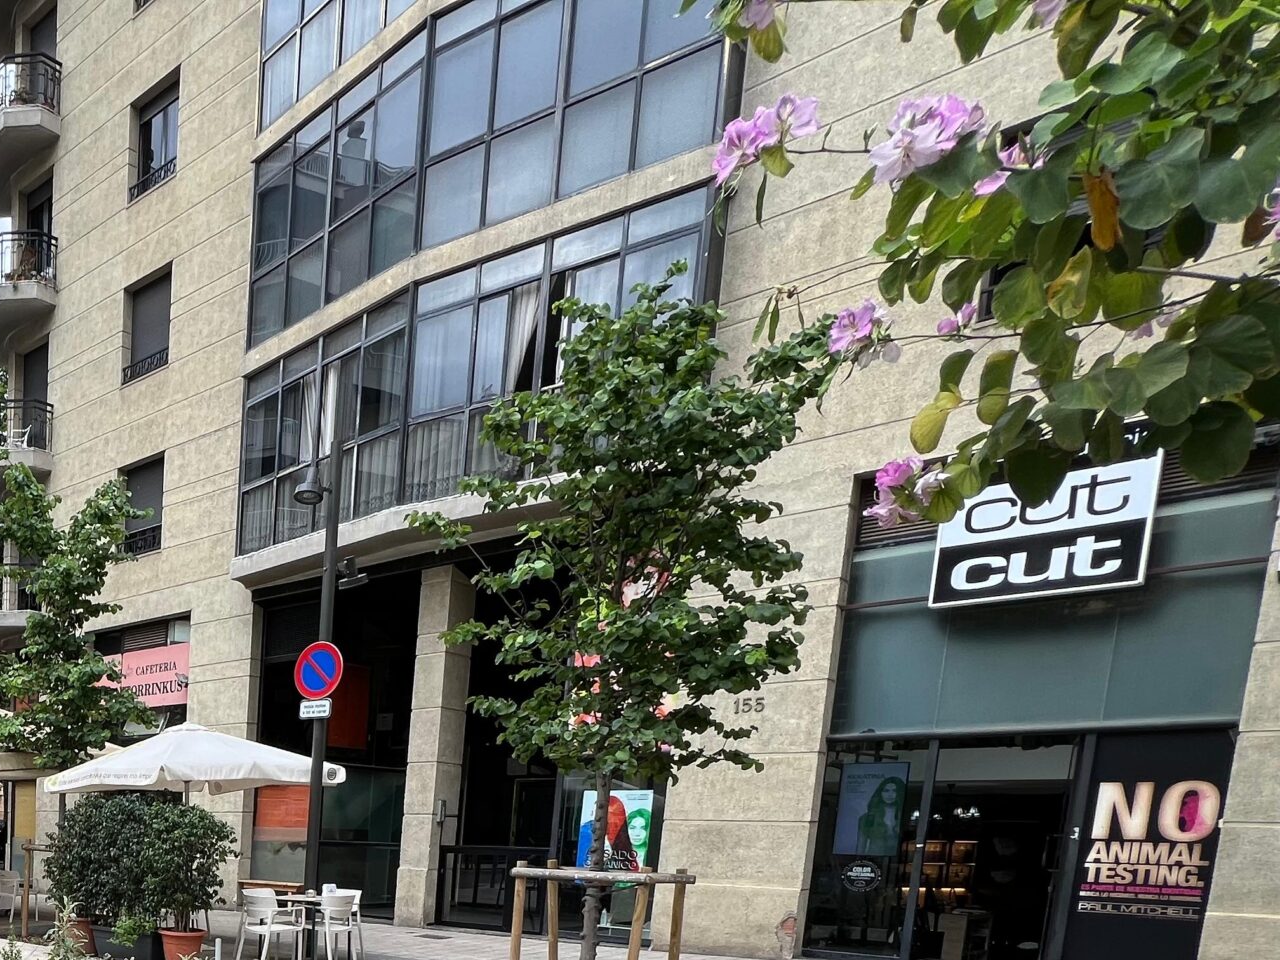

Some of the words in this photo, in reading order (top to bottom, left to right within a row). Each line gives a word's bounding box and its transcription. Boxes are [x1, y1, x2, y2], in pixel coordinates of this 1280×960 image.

[964, 474, 1131, 534] cut
[950, 535, 1123, 591] cut
[135, 661, 177, 676] CAFETERIA
[122, 680, 183, 697] ORRINKUS
[734, 697, 766, 715] 155
[1091, 780, 1221, 842] NO
[1085, 841, 1210, 867] ANIMAL
[1084, 862, 1205, 888] TESTING.
[1078, 902, 1118, 913] PAUL
[1120, 904, 1196, 916] MITCHELL
